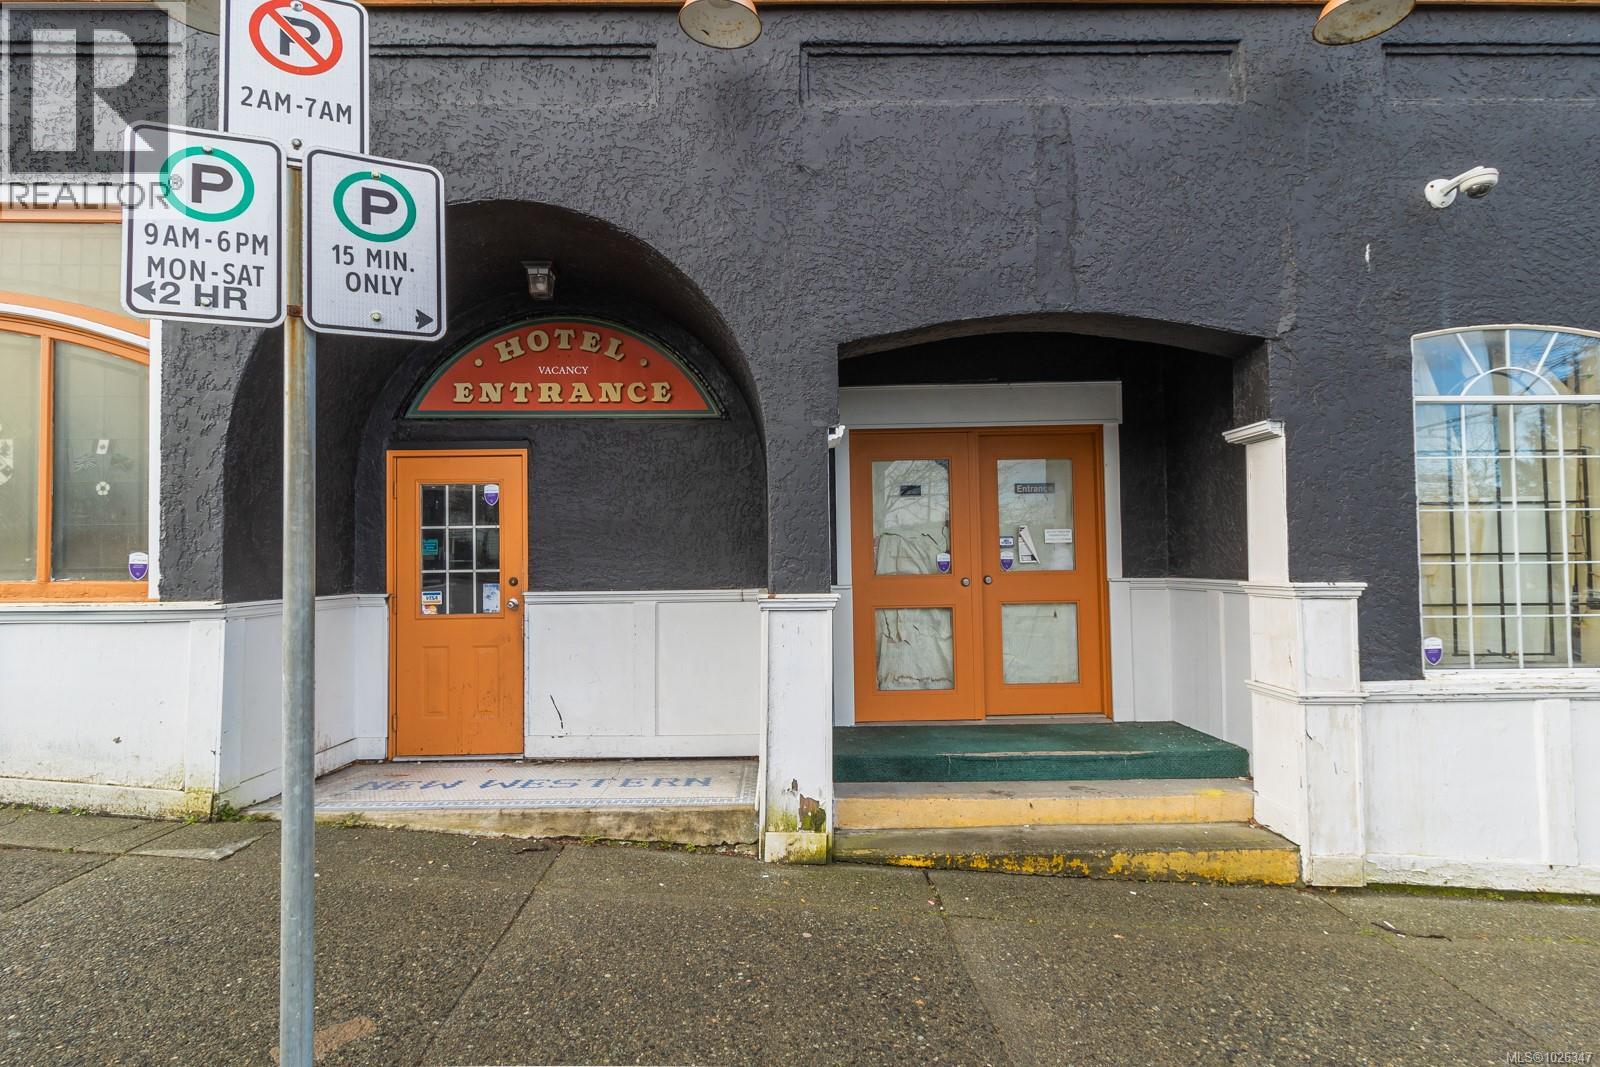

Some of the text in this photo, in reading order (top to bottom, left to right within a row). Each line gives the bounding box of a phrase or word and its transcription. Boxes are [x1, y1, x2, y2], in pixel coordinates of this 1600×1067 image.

[240, 86, 353, 125] 2AM-7AM
[191, 163, 234, 204] P
[361, 187, 399, 225] P
[144, 223, 270, 257] 9AM-6PM
[147, 256, 265, 288] MON-SAT
[331, 244, 416, 273] 15 MIN.
[160, 284, 248, 311] 2 HR
[345, 272, 404, 296] ONLY
[494, 329, 625, 363] HOTEL
[538, 365, 589, 376] VACANCY
[453, 381, 673, 404] ENTRANCE
[353, 776, 713, 791] NEW WESTERN
